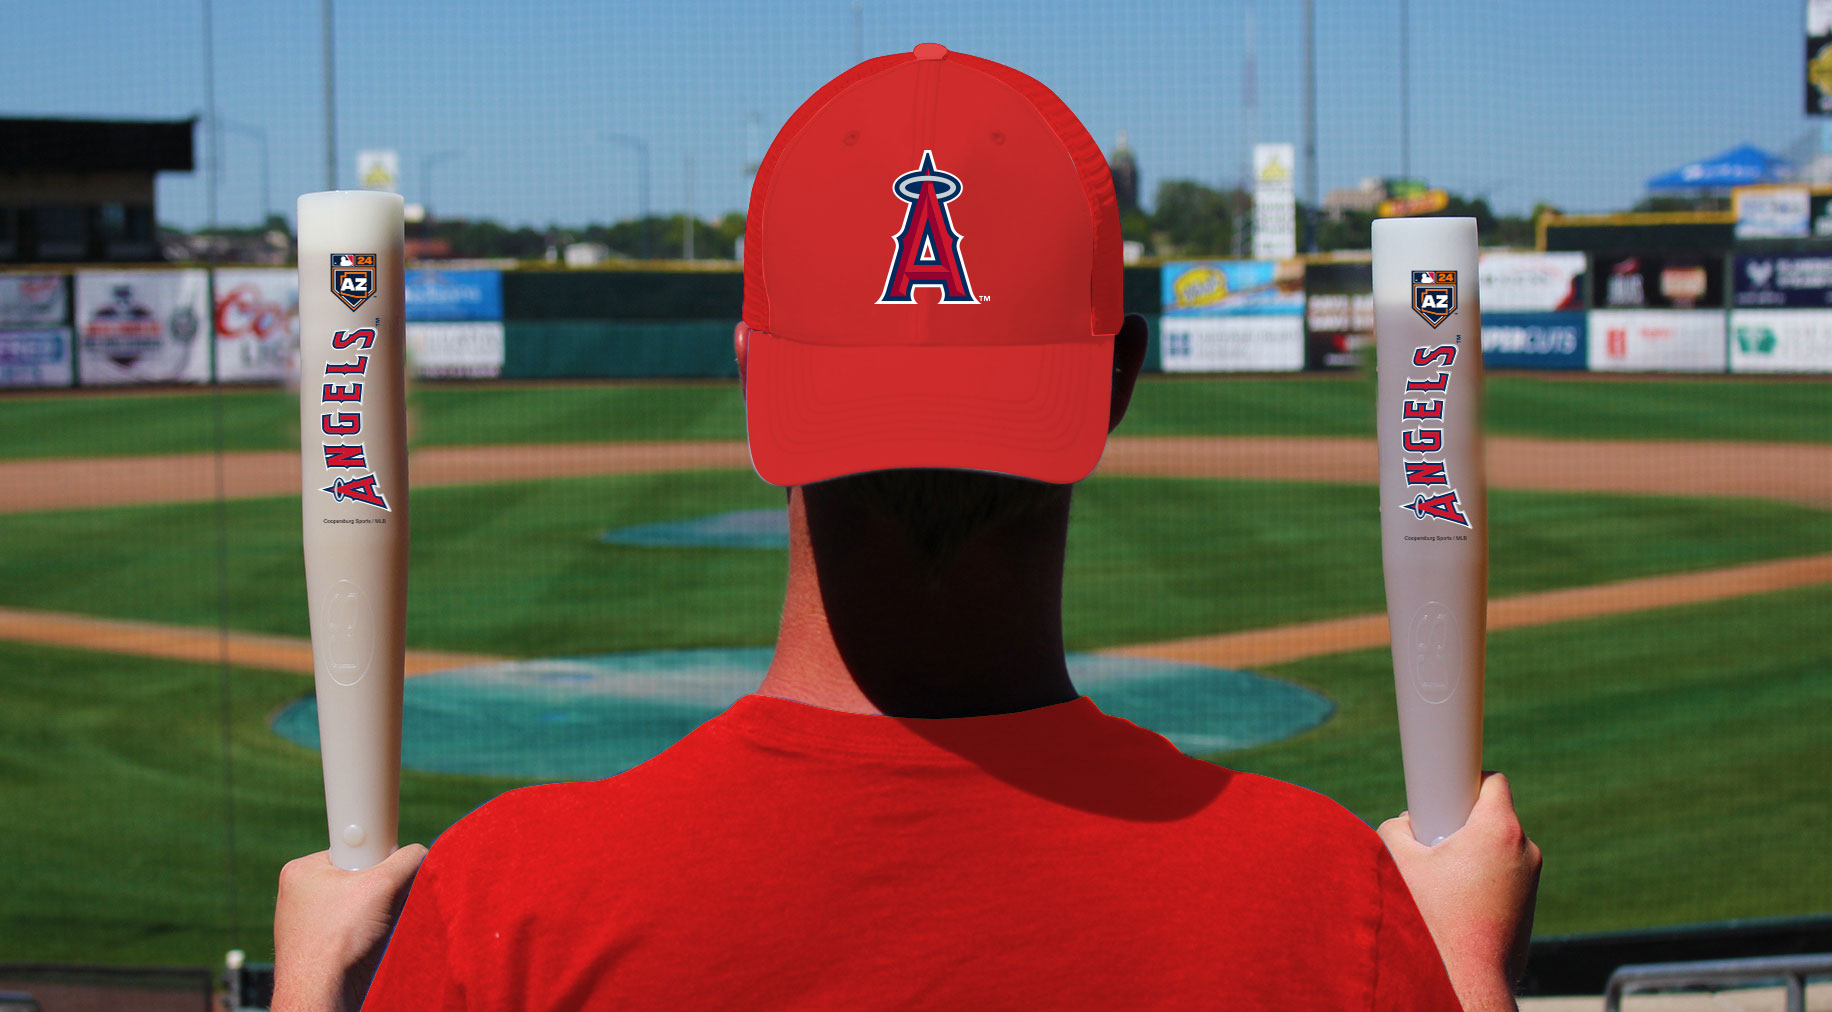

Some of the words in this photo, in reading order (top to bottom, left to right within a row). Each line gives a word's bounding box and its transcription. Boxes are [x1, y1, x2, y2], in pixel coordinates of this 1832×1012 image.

[874, 150, 982, 304] A
[357, 256, 373, 265] 24
[340, 277, 368, 291] AZ
[1438, 273, 1454, 282] 24
[1421, 294, 1448, 308] AZ
[317, 327, 392, 512] ANGELS
[1399, 343, 1473, 529] ANGELS
